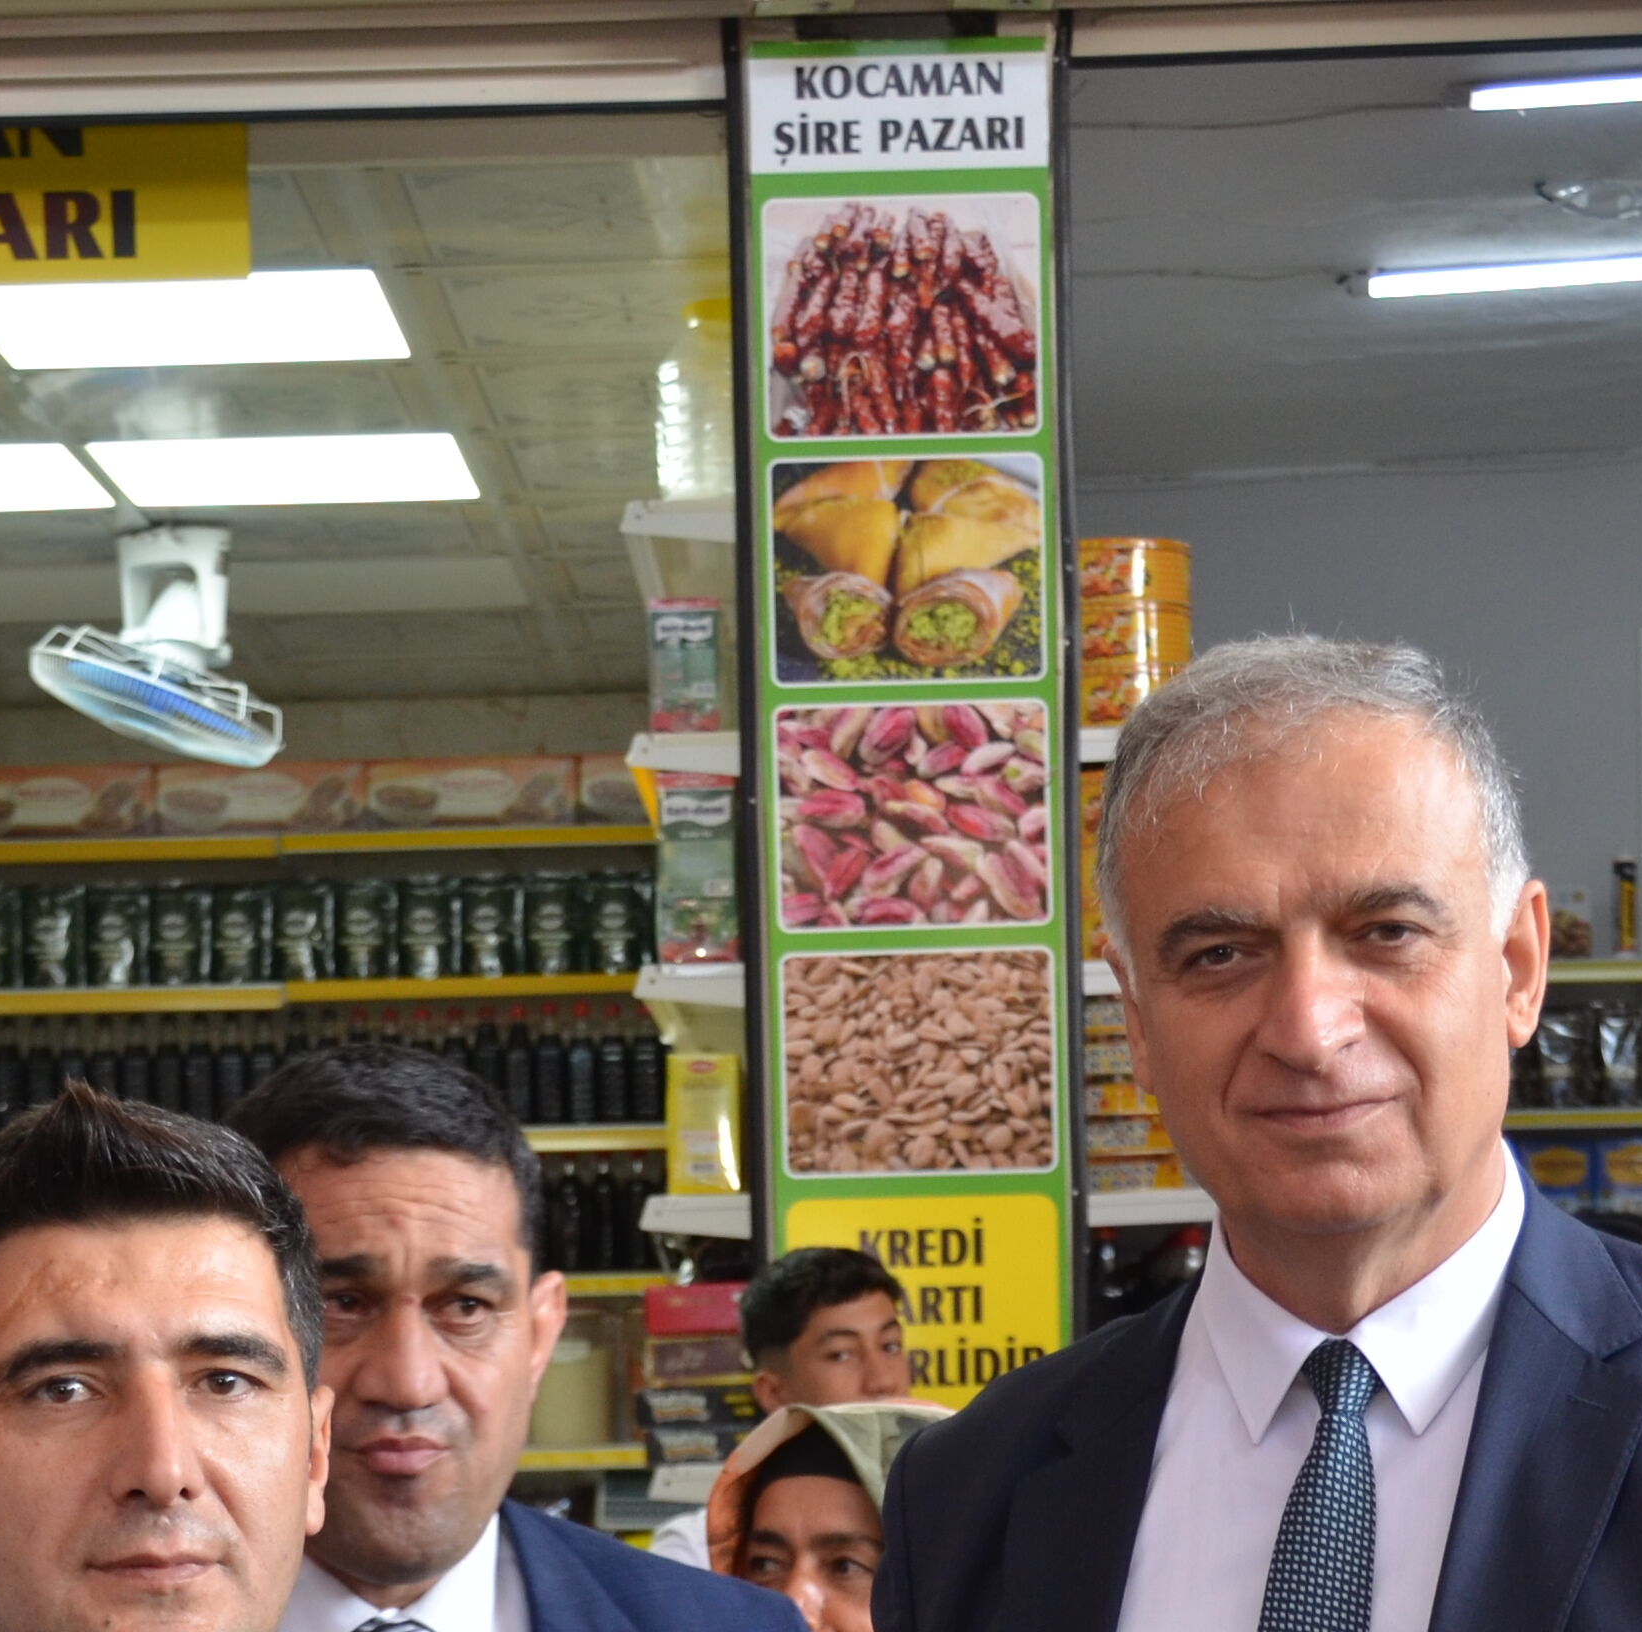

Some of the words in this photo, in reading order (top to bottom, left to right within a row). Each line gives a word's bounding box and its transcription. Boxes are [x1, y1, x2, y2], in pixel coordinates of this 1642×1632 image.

[794, 61, 1003, 100] KOCAMAN
[774, 113, 862, 166] ŞİRE
[880, 116, 1025, 153] PAZARI
[858, 1216, 985, 1268] KREDİ
